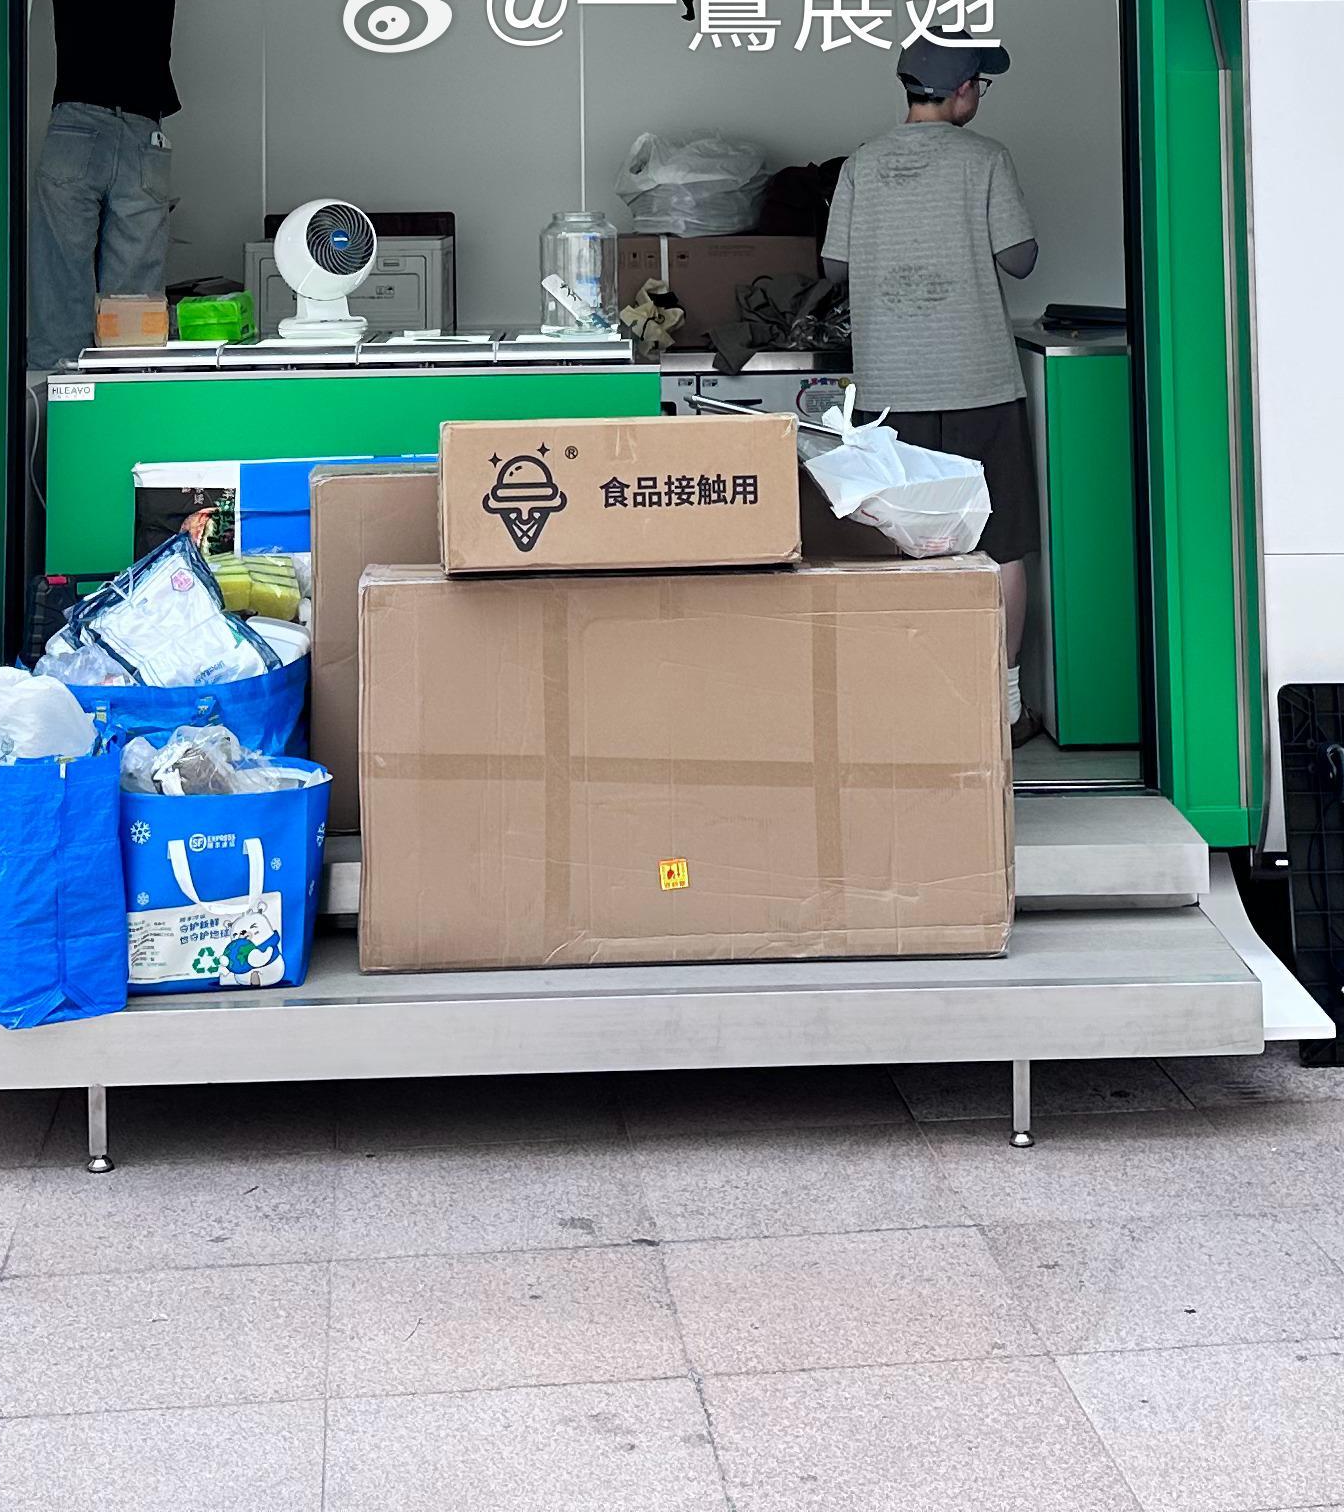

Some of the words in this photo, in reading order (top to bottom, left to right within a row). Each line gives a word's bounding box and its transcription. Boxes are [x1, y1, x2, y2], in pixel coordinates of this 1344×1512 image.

[600, 474, 759, 509] 食品接触用
